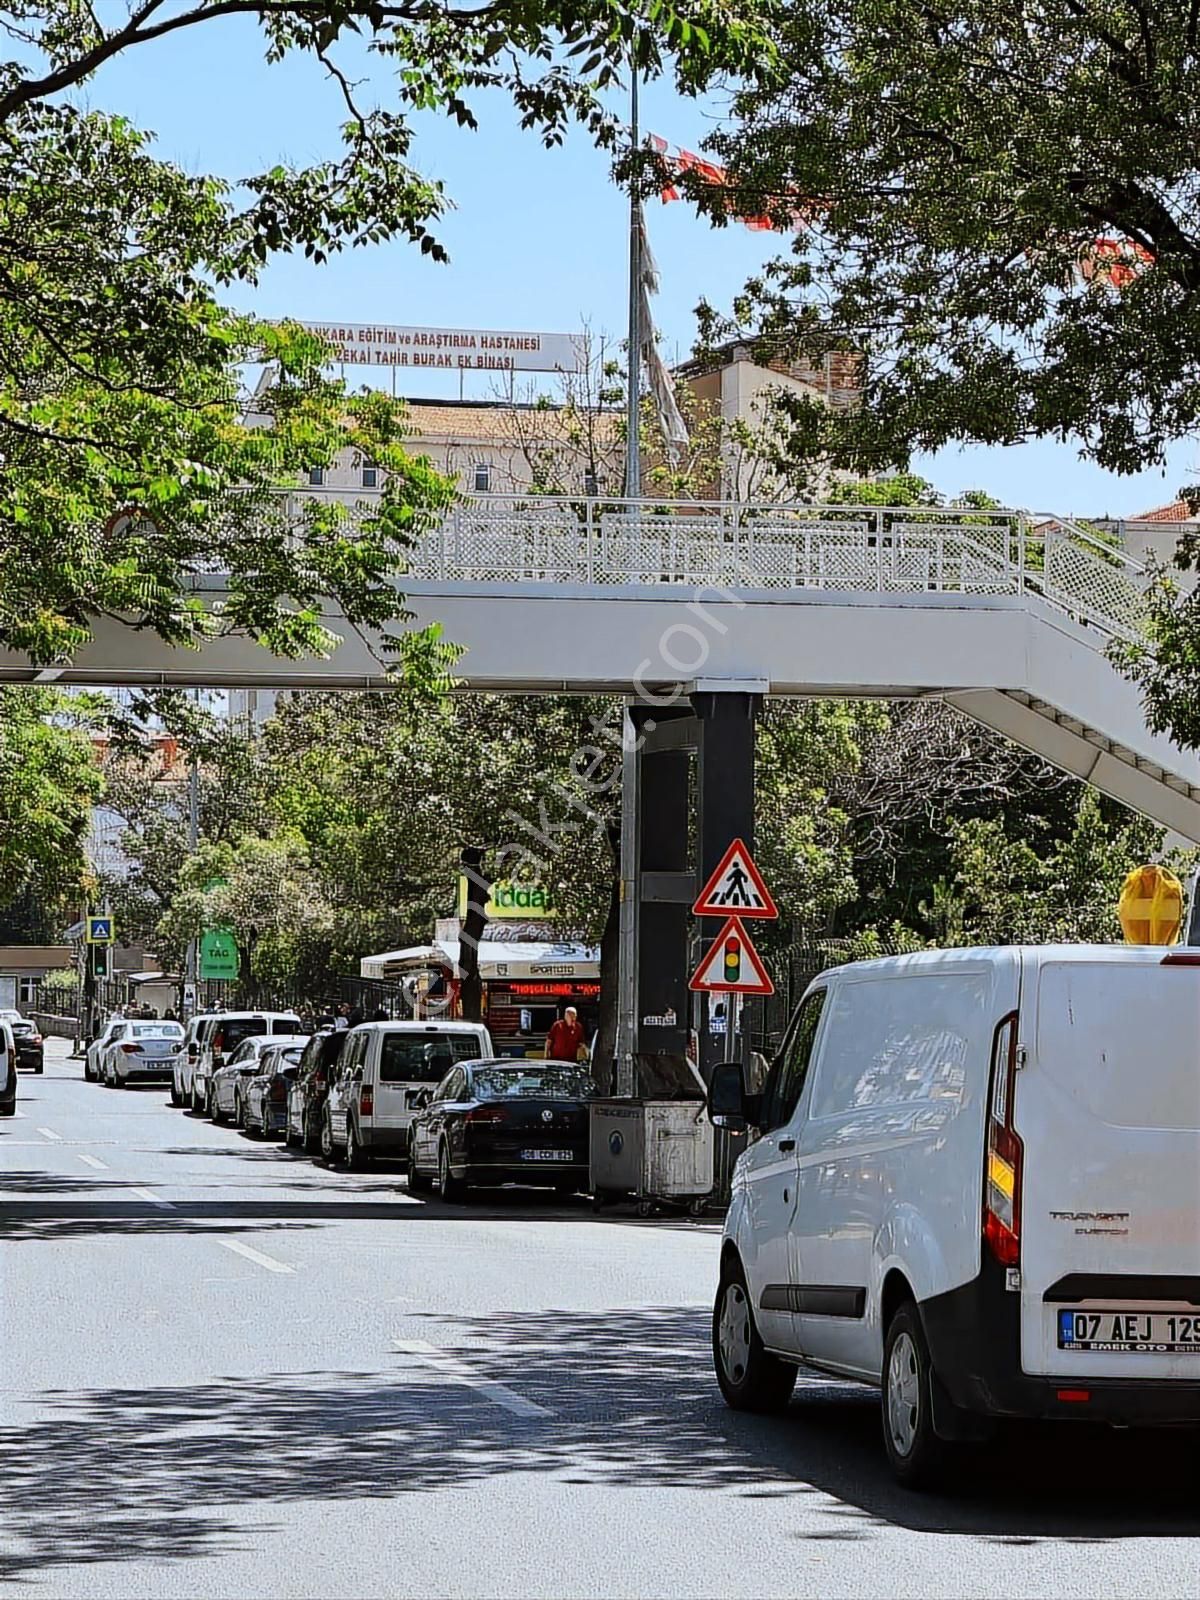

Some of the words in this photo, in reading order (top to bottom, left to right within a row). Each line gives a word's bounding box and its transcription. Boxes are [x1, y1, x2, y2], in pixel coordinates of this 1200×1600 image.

[358, 327, 398, 344] EĞİTİM
[398, 334, 411, 344] ve
[413, 333, 477, 349] ARAŞTIRMA
[481, 335, 540, 351] HASTANESİ
[335, 346, 371, 364] ZEKAİ
[375, 348, 408, 365] TAHİR
[413, 353, 452, 366] BURAK
[458, 355, 472, 368] EK
[477, 352, 514, 370] BİNASI
[1075, 1315, 1101, 1340] 07
[1111, 1315, 1152, 1341] AEJ
[1090, 1343, 1131, 1351] EMEK
